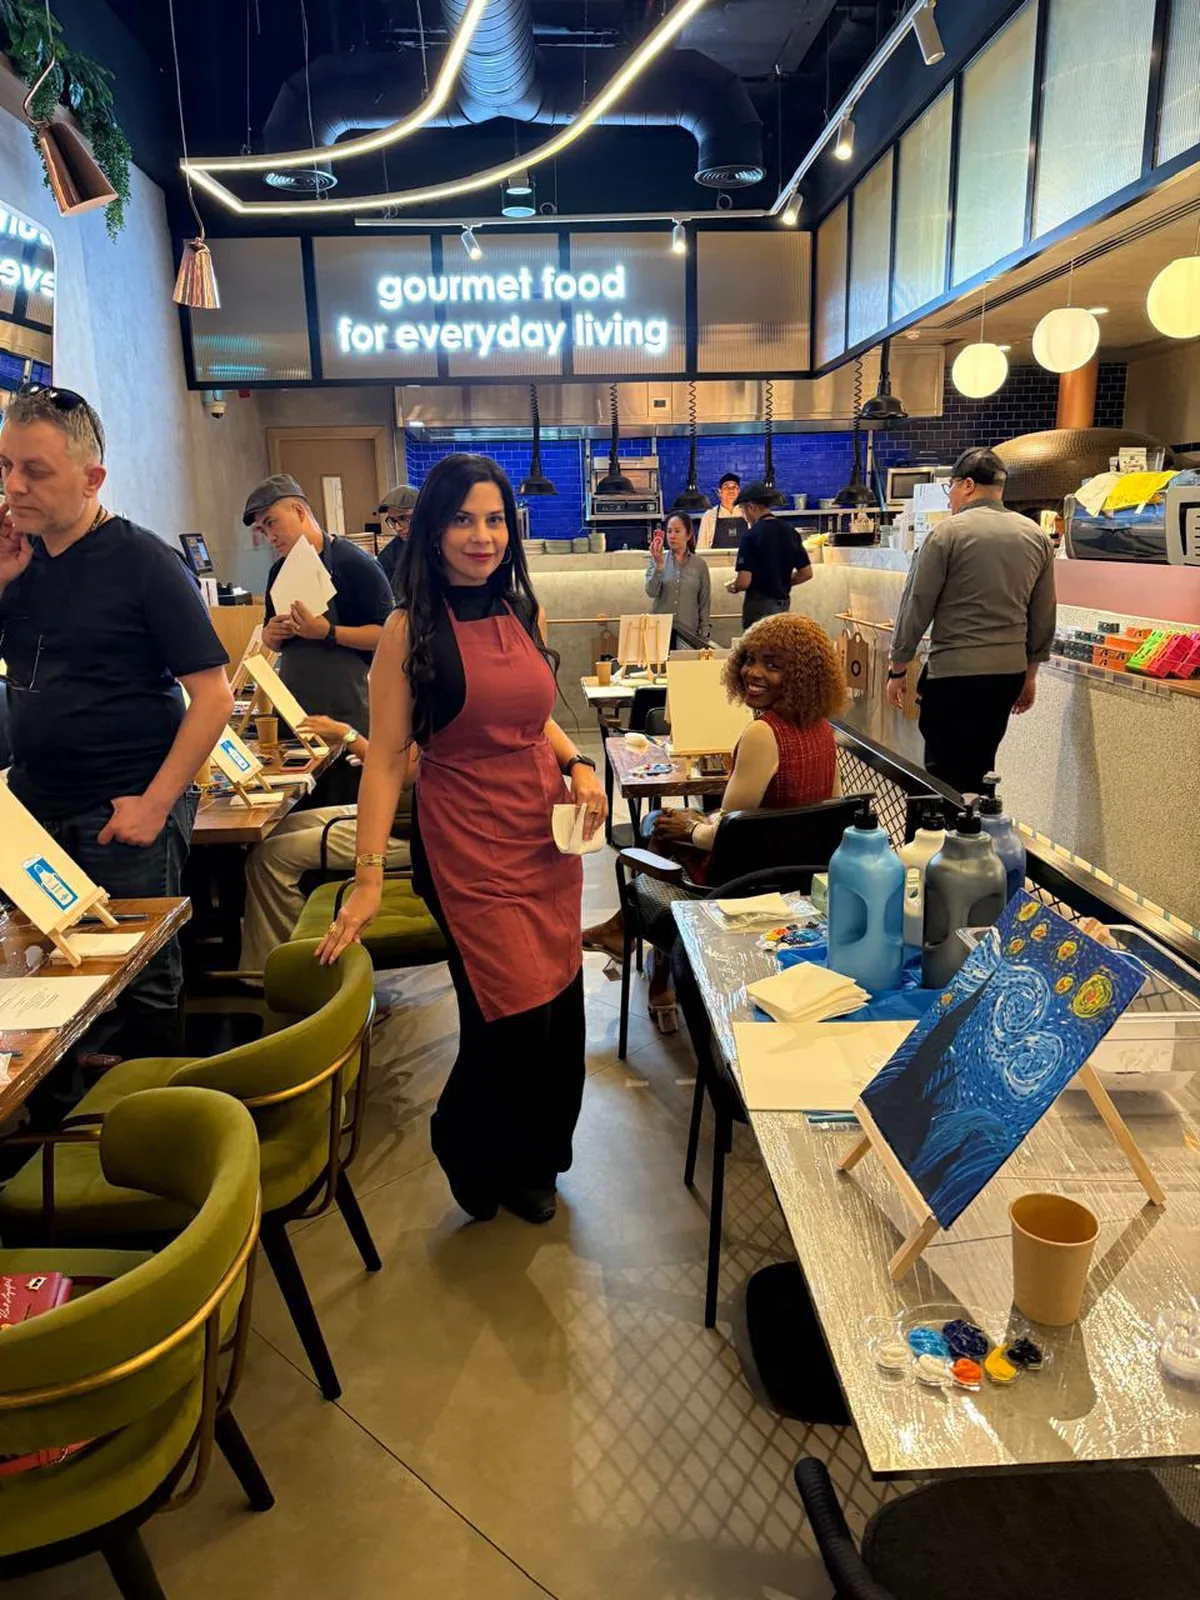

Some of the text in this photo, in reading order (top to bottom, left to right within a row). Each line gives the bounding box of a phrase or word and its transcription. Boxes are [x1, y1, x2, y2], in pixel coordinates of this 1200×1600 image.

[377, 264, 626, 310] gourmet food
[338, 312, 668, 357] for everyday living
